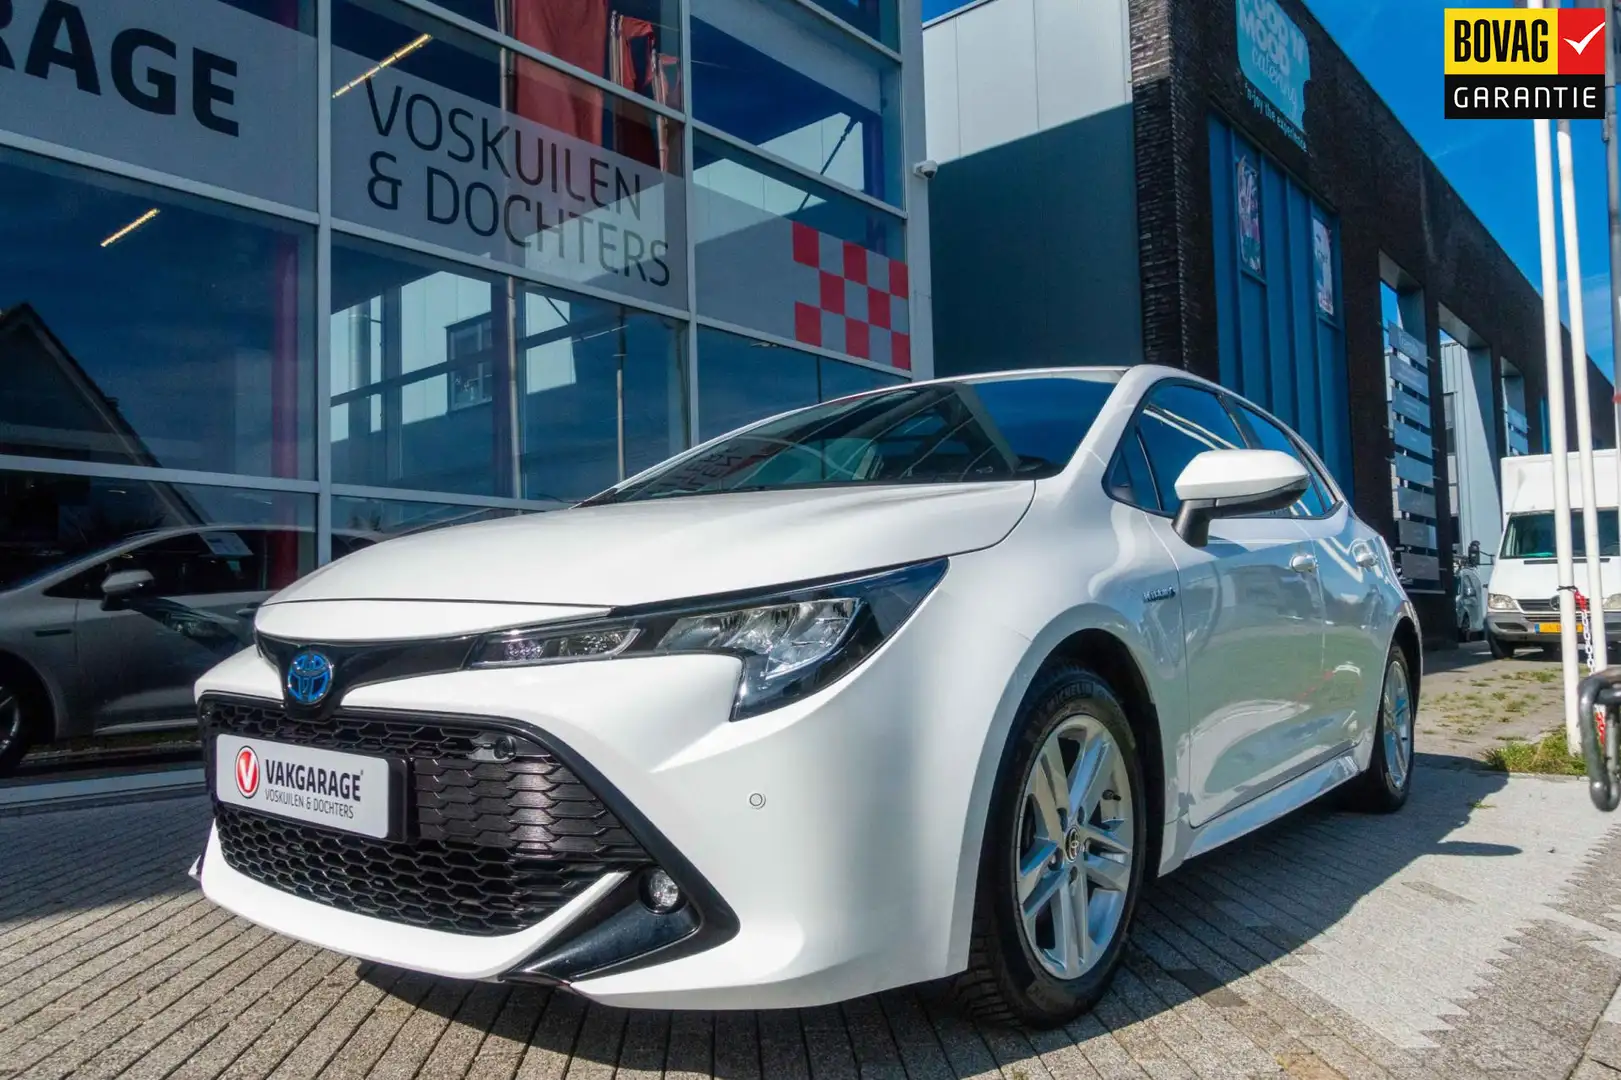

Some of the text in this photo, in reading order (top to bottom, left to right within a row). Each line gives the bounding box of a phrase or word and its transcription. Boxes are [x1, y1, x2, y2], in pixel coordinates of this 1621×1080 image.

[0, 0, 239, 137] AGE
[366, 77, 641, 221] VOSKUILEN
[367, 150, 670, 287] & DOCHTERS
[265, 788, 354, 820] VOSKUILEN & DOCHTERS
